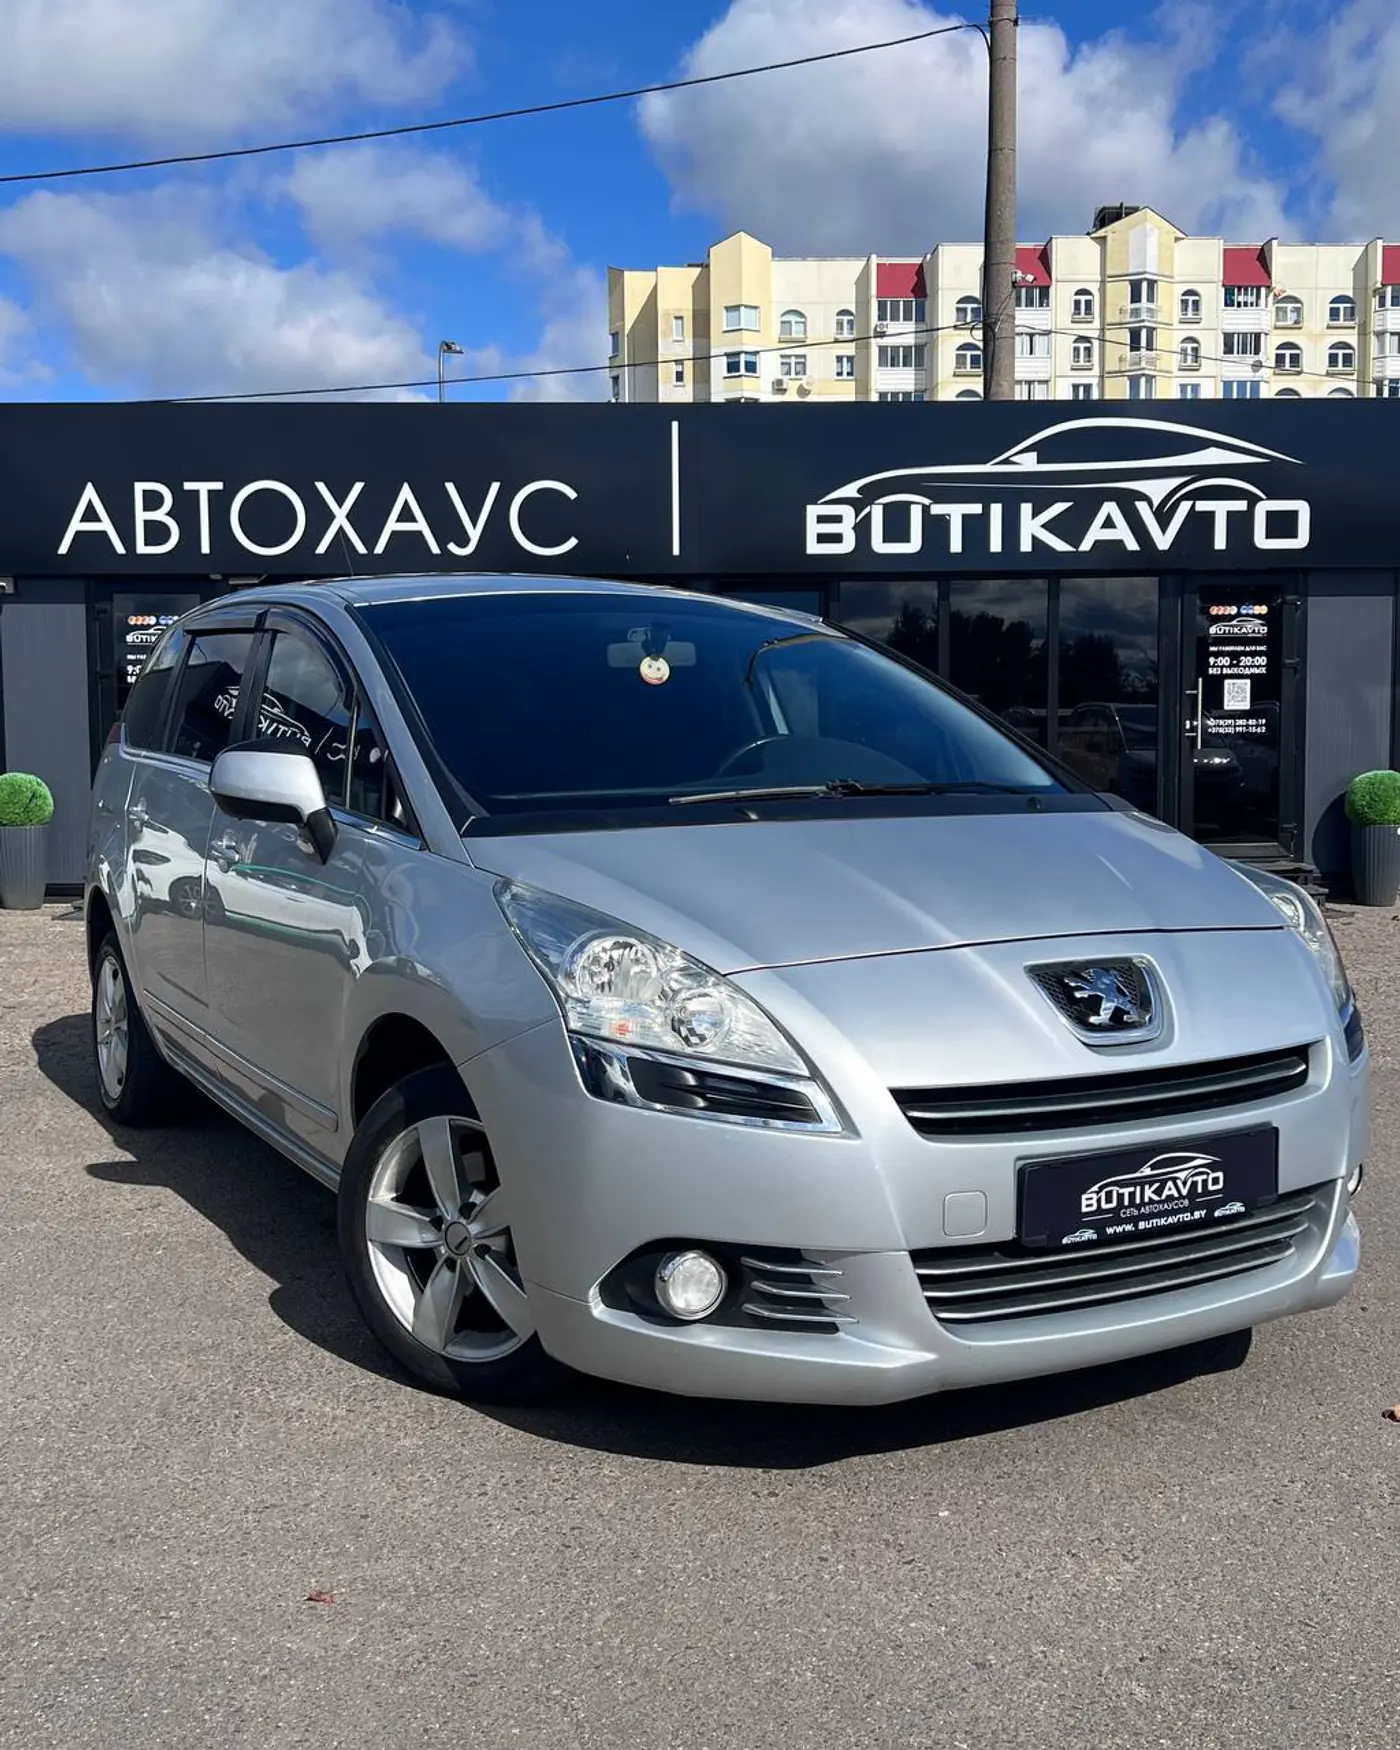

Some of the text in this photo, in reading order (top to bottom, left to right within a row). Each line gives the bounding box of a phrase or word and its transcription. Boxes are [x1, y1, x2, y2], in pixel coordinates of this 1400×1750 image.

[57, 480, 579, 557] АВТОХАУС
[805, 498, 1311, 556] BUTIKAVTO
[1208, 626, 1268, 635] BUTIKAVTO
[1208, 656, 1231, 666] 9:00
[1239, 656, 1267, 666] 20:00
[1208, 667, 1267, 675] БЕЗ ВЫХОДНЫХ
[1081, 1171, 1224, 1213] BUTIKAVTO
[1119, 1199, 1190, 1218] СЕТЬ АВТОХАУСОВ
[1106, 1209, 1207, 1235] WWW. BUTIKAVTO.BY
